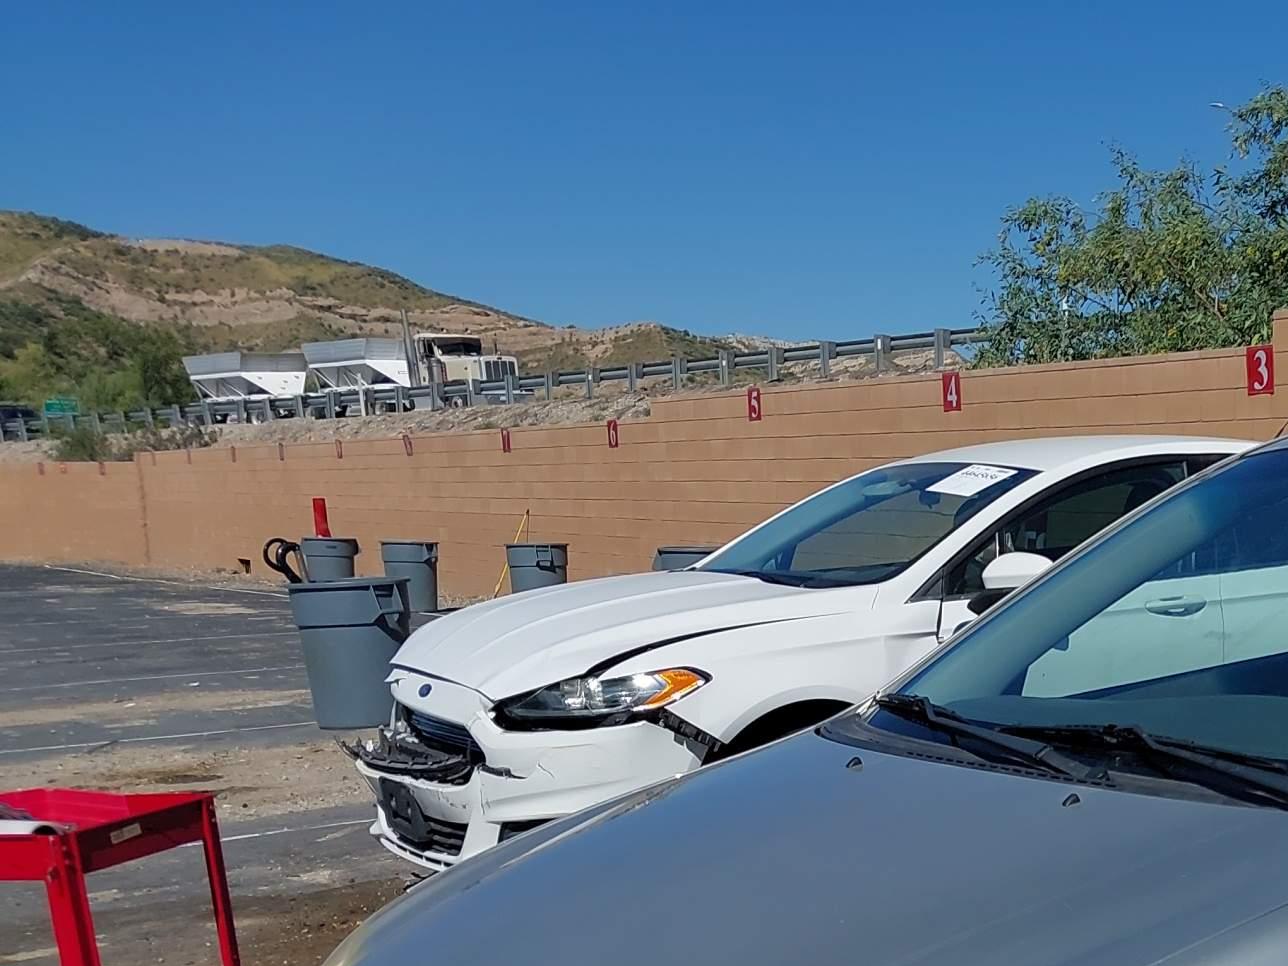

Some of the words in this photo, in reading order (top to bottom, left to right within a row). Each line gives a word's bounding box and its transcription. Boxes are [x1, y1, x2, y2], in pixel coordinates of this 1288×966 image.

[1253, 350, 1269, 391] 3
[751, 391, 759, 418] 5
[947, 375, 958, 408] 4
[610, 422, 616, 446] 6
